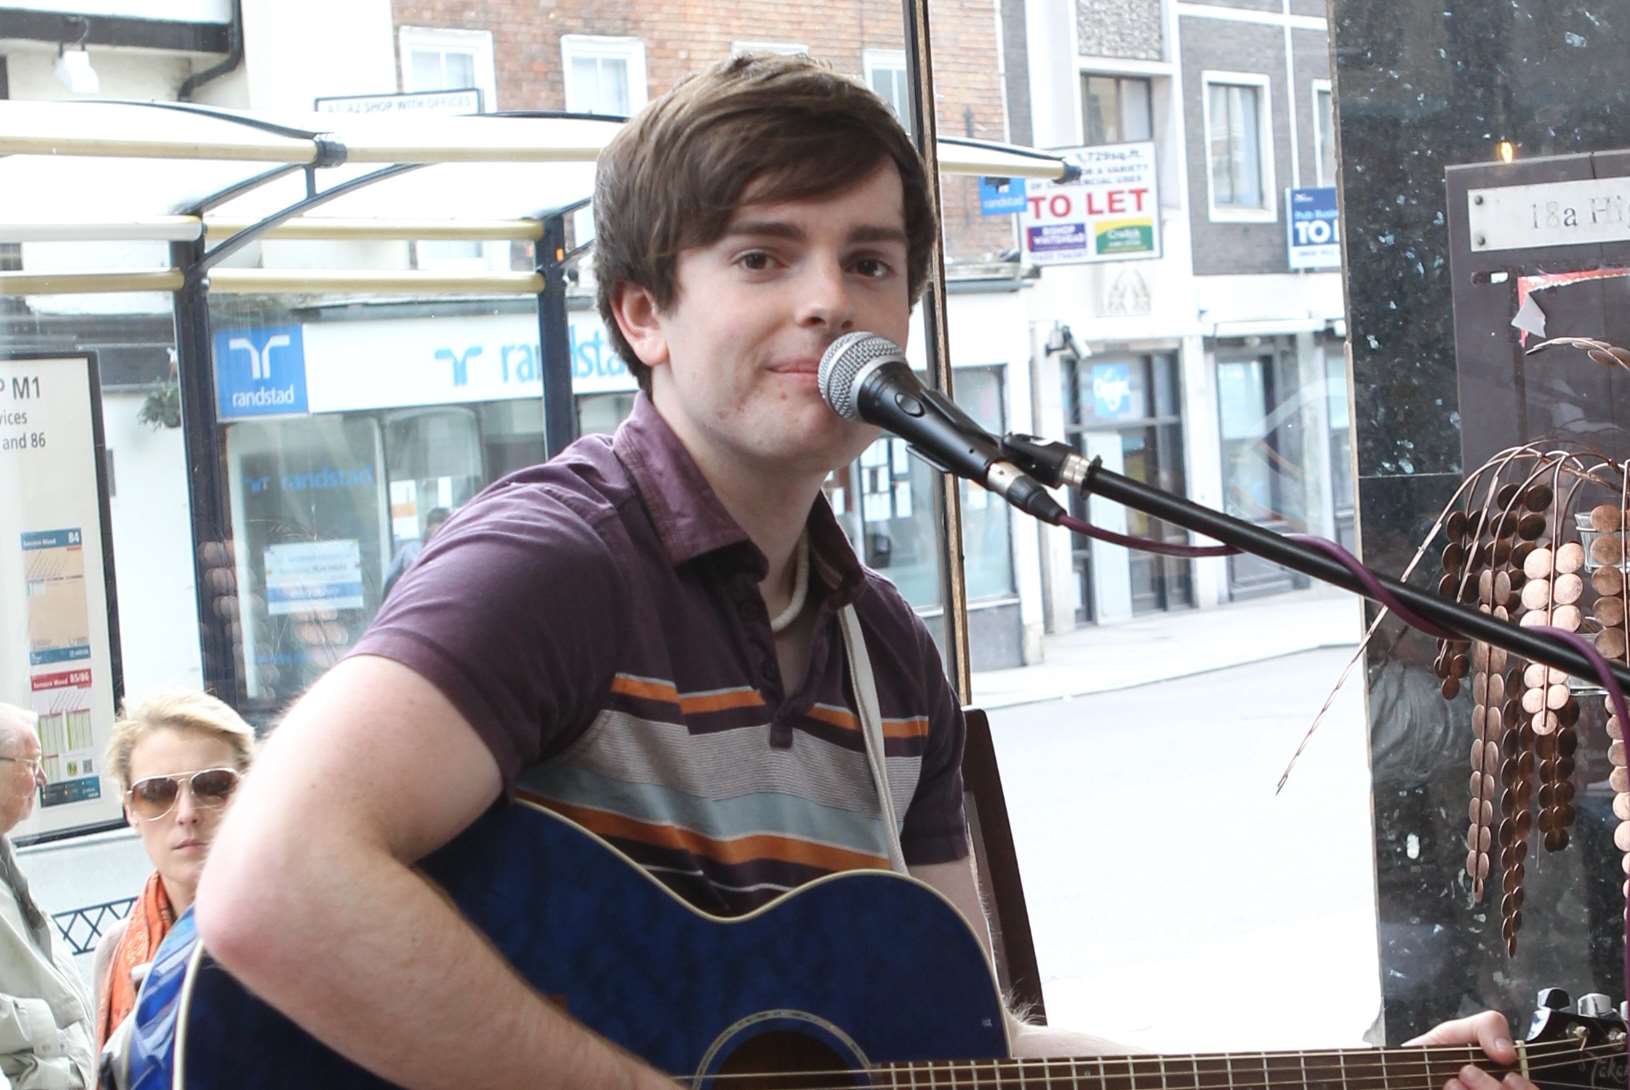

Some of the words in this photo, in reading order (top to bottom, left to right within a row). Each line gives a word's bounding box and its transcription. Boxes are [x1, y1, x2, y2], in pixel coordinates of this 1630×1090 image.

[1028, 194, 1072, 219] TO
[1087, 188, 1149, 216] LET
[1532, 200, 1579, 229] 18a
[1295, 219, 1331, 244] TO
[12, 376, 40, 400] M1
[232, 384, 295, 408] randstad
[3, 432, 27, 450] and
[31, 431, 46, 449] 86
